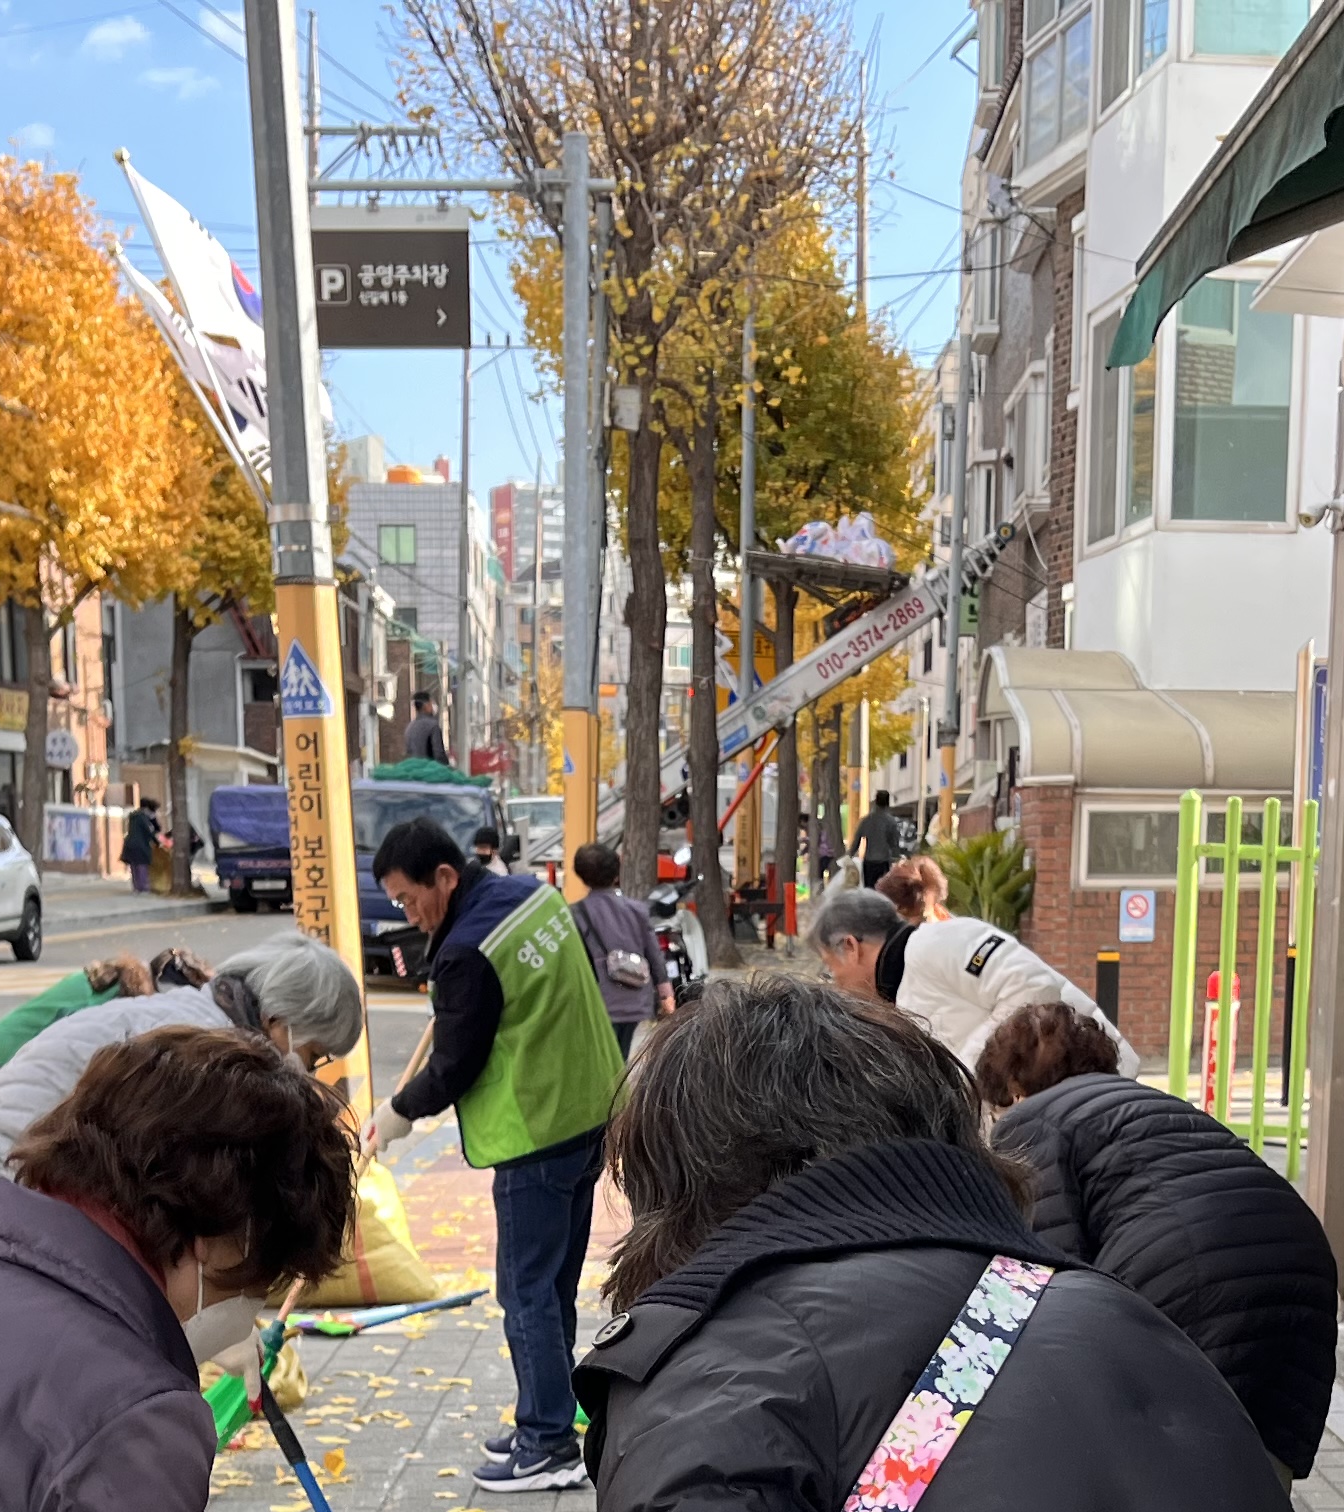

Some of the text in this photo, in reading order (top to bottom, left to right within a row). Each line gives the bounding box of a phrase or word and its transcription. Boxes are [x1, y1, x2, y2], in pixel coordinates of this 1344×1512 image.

[357, 262, 449, 289] 공영주차장
[816, 596, 925, 680] 010-3574-2869
[295, 730, 323, 820] 어린이
[517, 906, 577, 969] 영등포구
